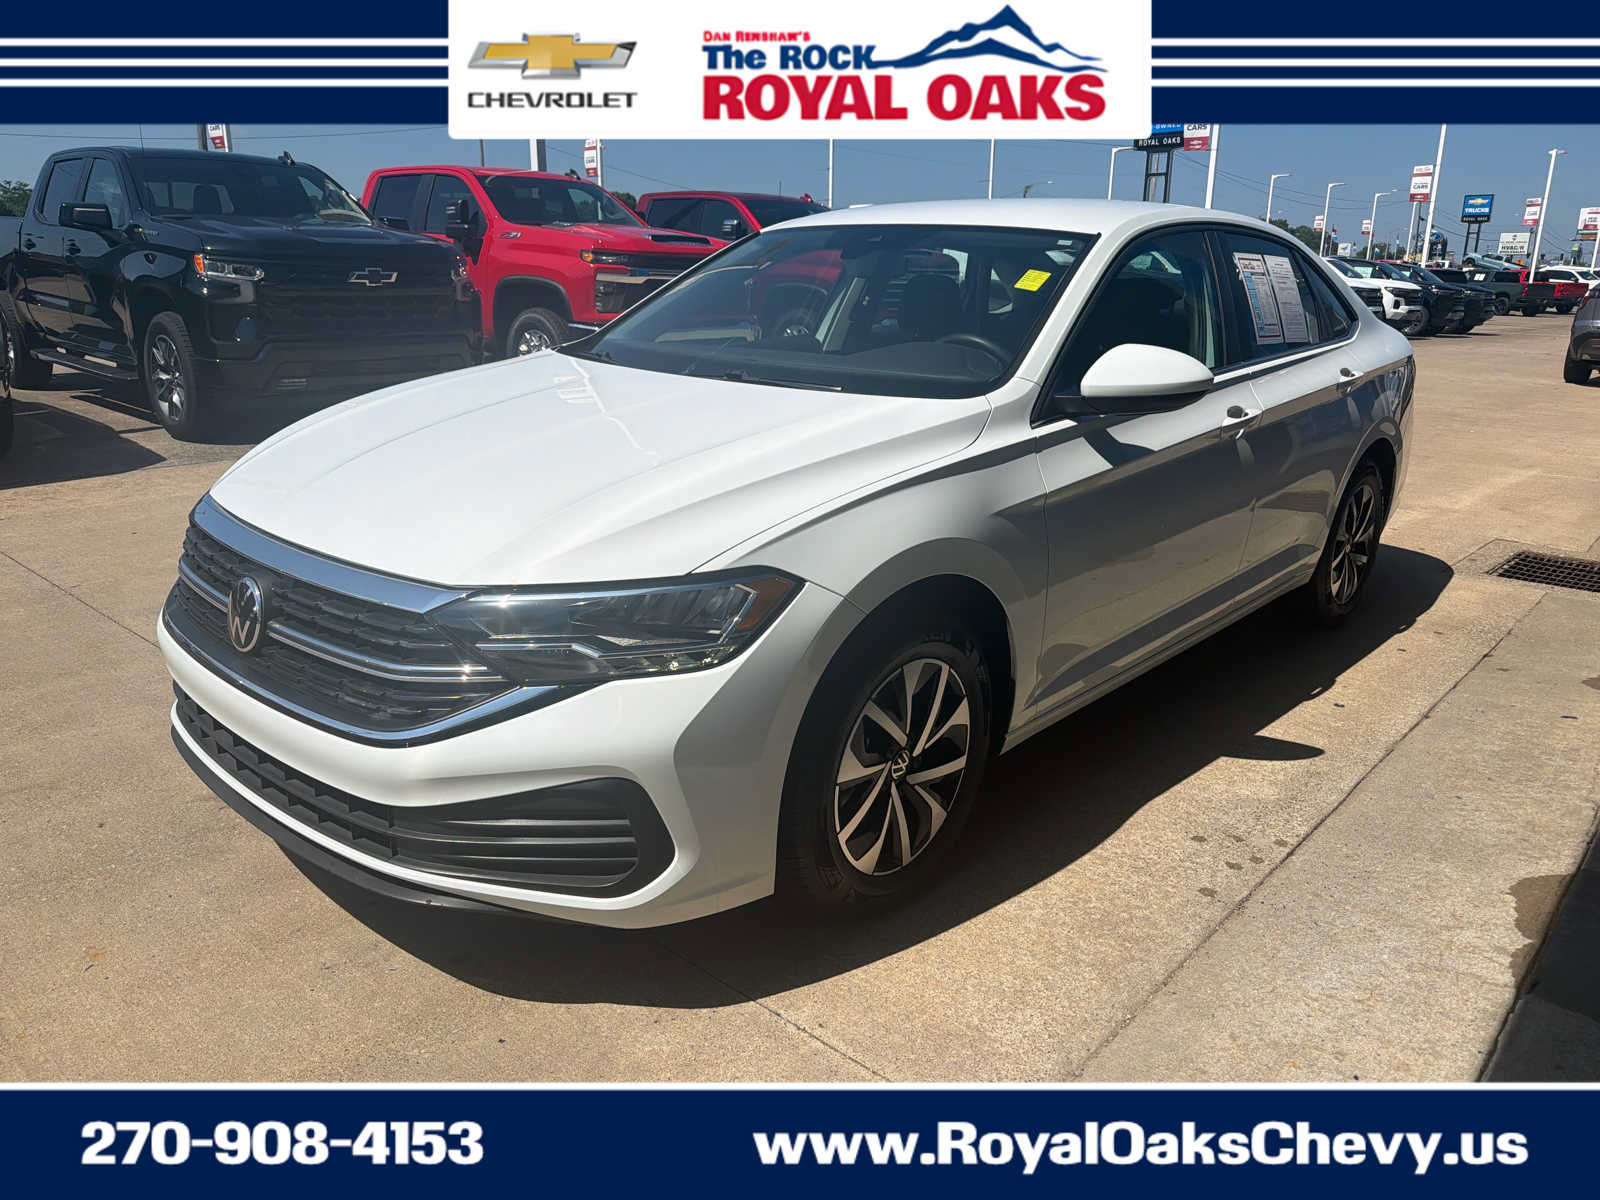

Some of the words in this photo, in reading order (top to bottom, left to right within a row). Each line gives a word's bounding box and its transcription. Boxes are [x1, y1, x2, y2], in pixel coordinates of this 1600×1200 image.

[1186, 123, 1208, 132] CARS
[1138, 138, 1160, 147] ROYAL
[1163, 136, 1181, 145] OAKS
